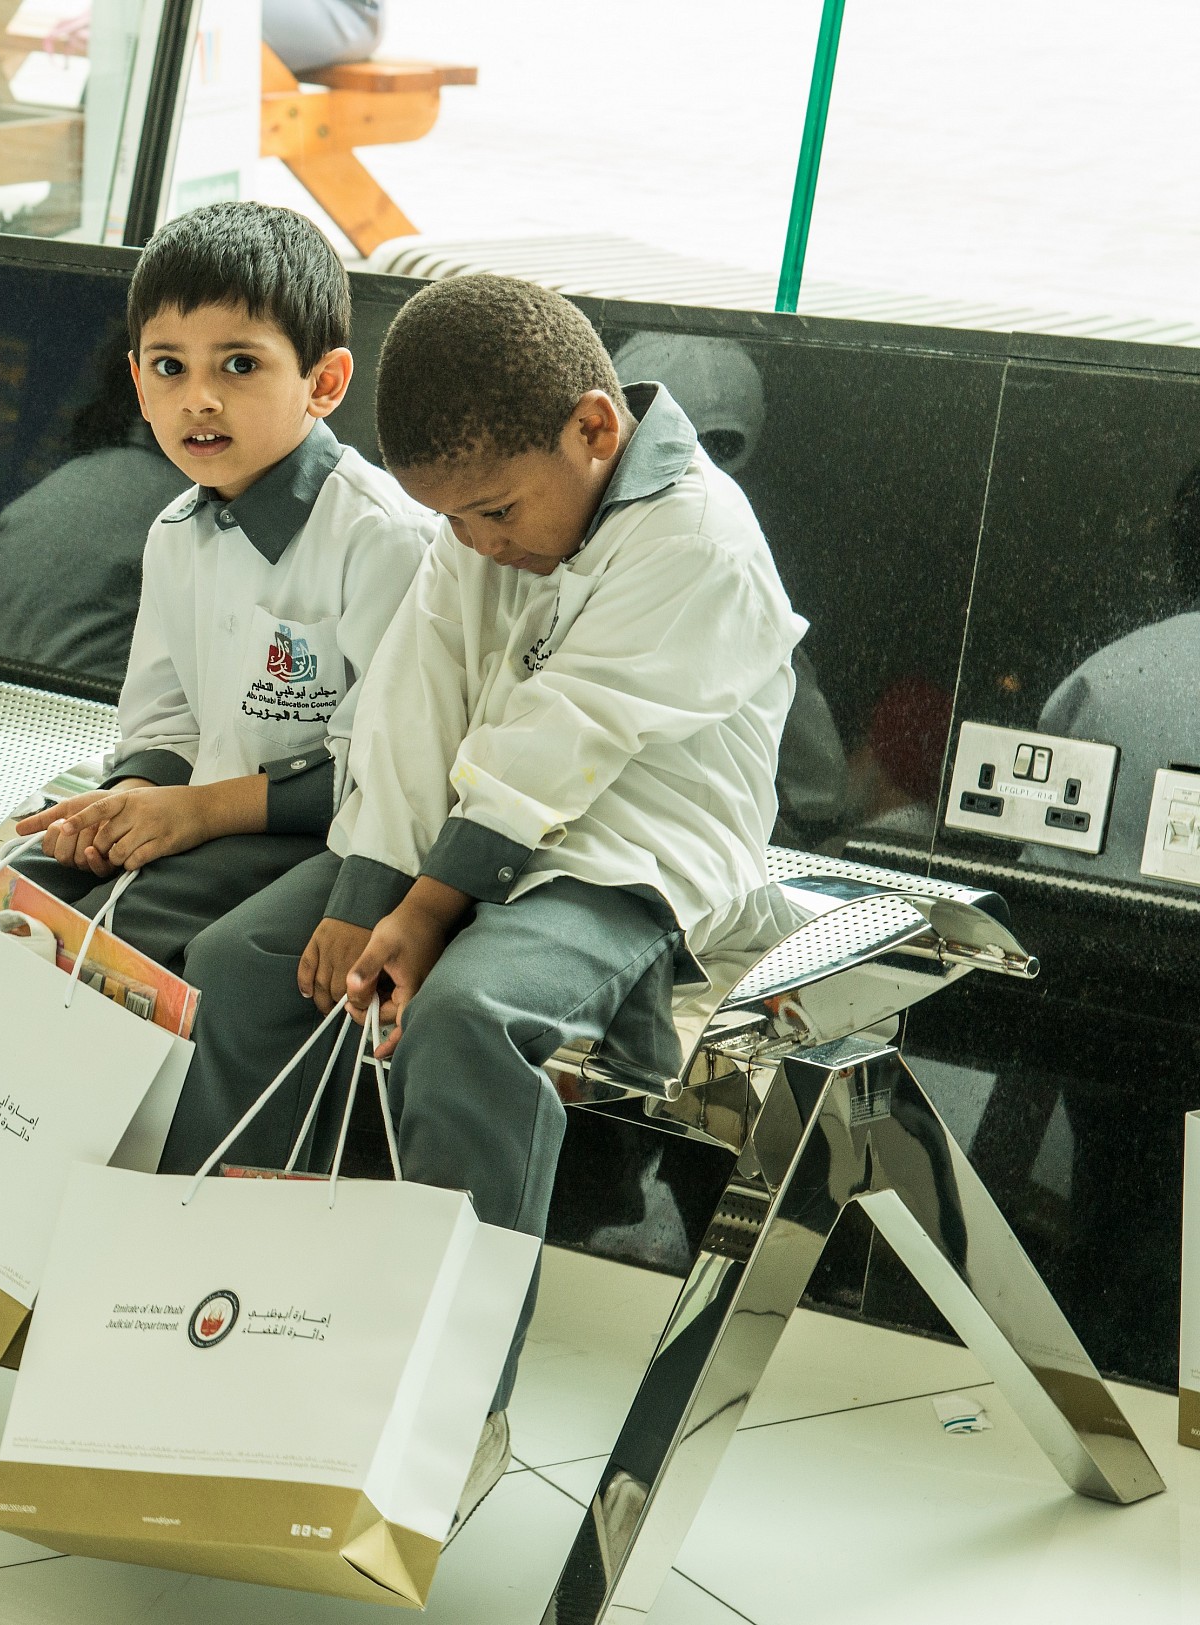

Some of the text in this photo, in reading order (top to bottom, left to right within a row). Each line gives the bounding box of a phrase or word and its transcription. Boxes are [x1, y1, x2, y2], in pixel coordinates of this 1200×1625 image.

[246, 691, 336, 708] Abu Dhabi Education Council
[292, 711, 332, 724] وضة
[8, 1102, 40, 1130] إمارة
[0, 1117, 30, 1142] دائرة
[164, 1304, 186, 1314] Dhabi
[106, 1319, 179, 1332] Judicial Department
[242, 1323, 325, 1341] دائرة القضاء
